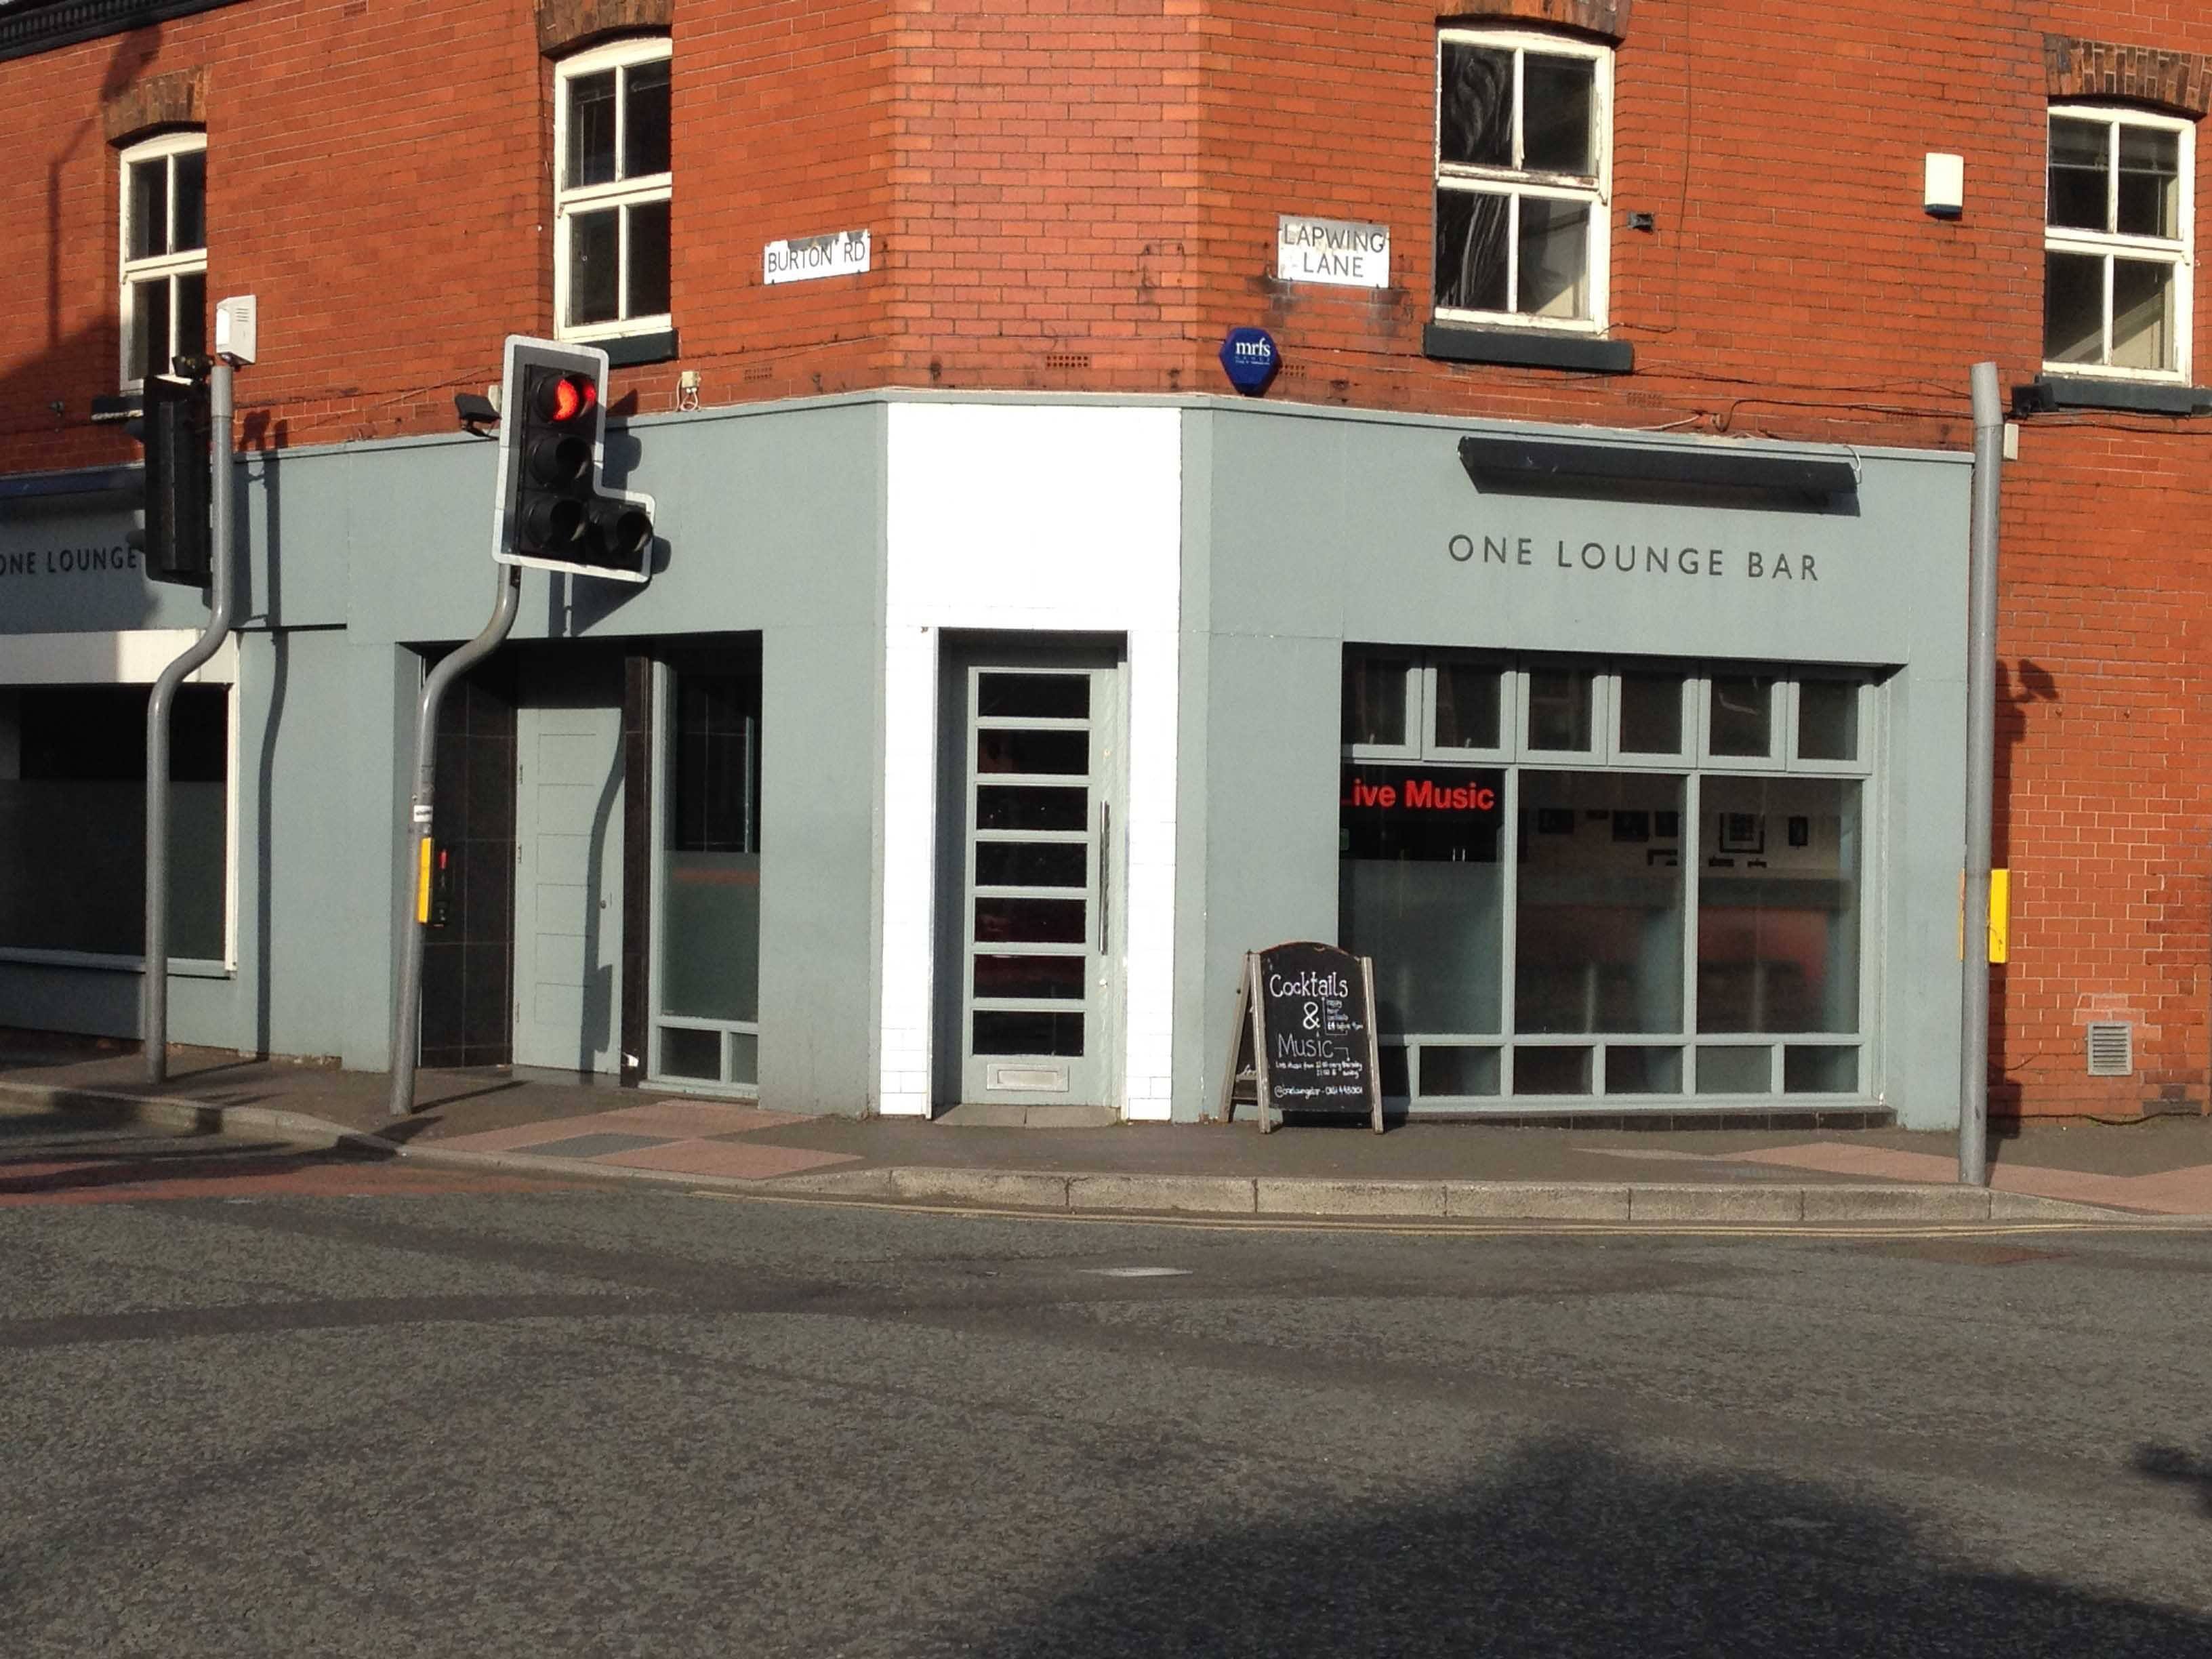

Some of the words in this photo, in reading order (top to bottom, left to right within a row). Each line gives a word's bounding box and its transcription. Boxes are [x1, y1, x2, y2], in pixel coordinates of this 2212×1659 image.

[1284, 223, 1384, 253] LAPWING
[769, 242, 832, 273] BURTON
[844, 241, 865, 263] RD
[1303, 252, 1364, 278] LANE
[1235, 337, 1271, 357] mrfs
[48, 546, 137, 573] LOUNGE
[1448, 534, 1532, 565] ONE
[1558, 541, 1723, 576] LOUNGE
[1748, 552, 1818, 581] BAR
[1342, 779, 1397, 807] ive
[1405, 780, 1495, 811] Music
[1269, 971, 1349, 998] Cocktails
[1303, 1001, 1321, 1029] &
[1277, 1031, 1334, 1059] Music
